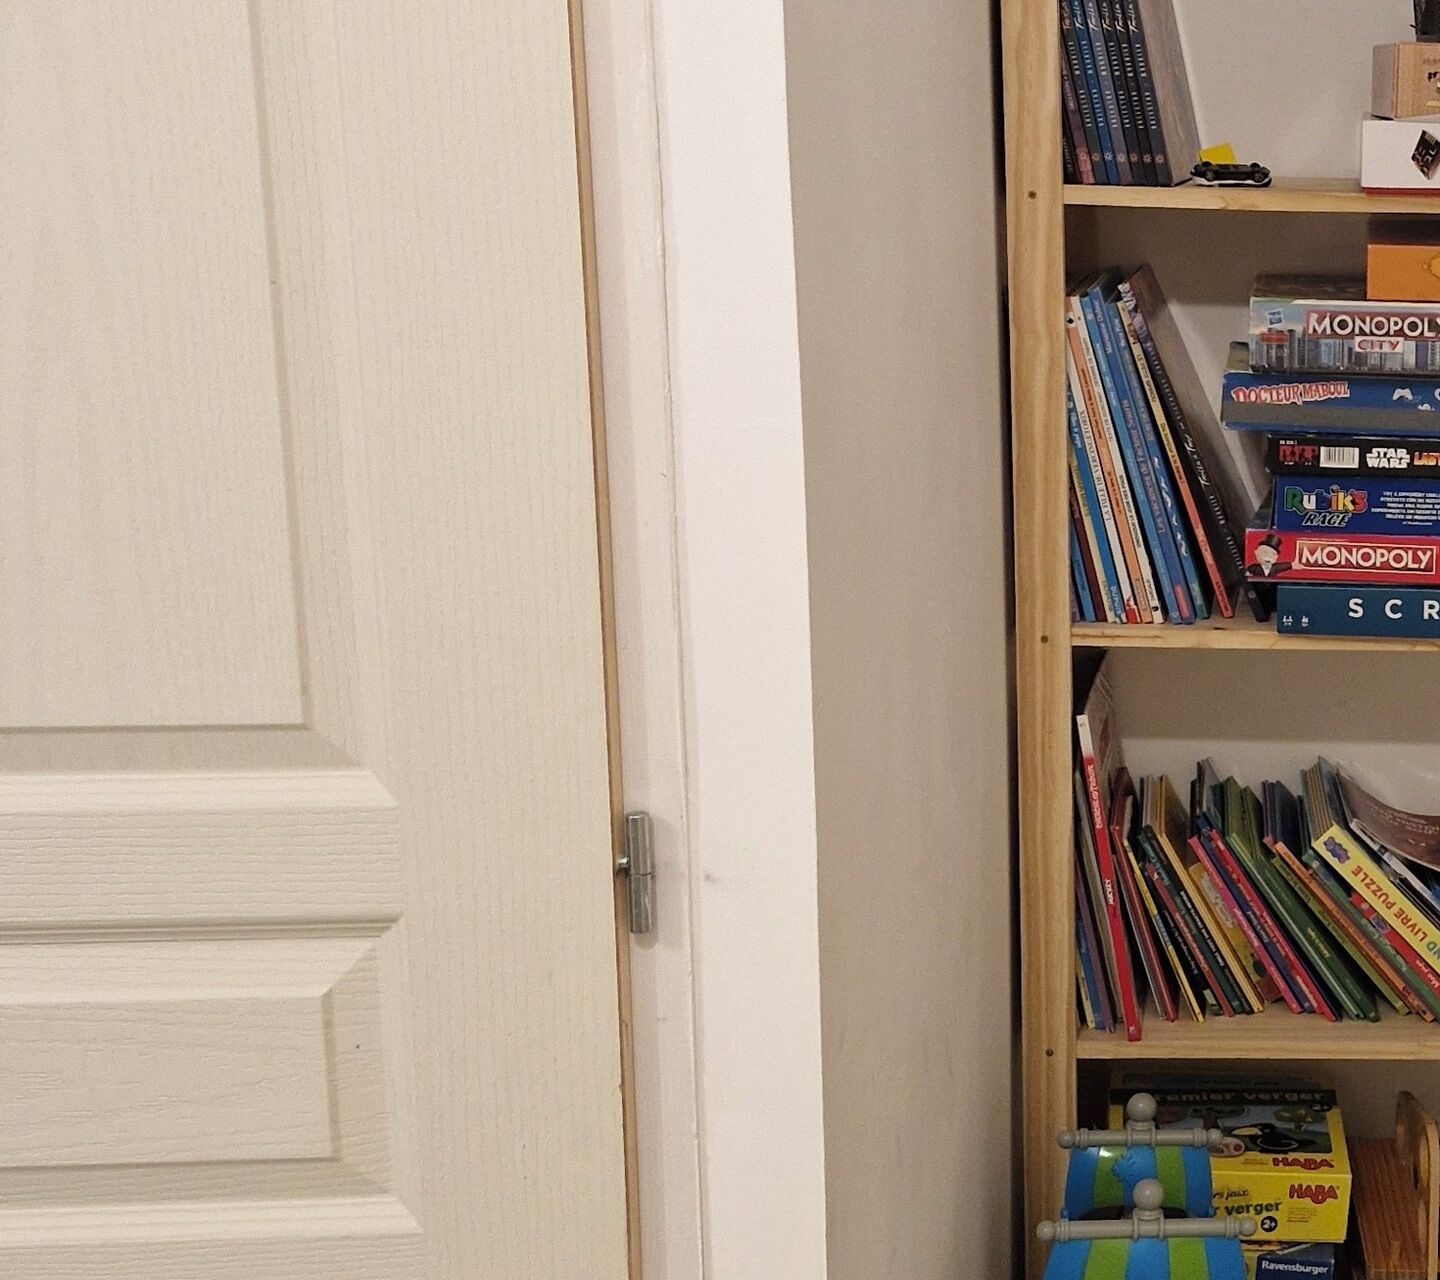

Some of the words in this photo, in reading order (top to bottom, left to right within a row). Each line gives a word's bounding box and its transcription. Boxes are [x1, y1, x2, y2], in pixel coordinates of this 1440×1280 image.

[1357, 339, 1400, 351] CITY
[1232, 385, 1300, 404] DOCTEUR
[1302, 381, 1349, 399] MABOUL
[1366, 448, 1411, 459] STAR
[1366, 458, 1410, 468] WARS
[1302, 512, 1352, 527] RACE
[1301, 546, 1432, 569] MONOPOLY
[1350, 861, 1397, 913] PUZZLE
[1392, 904, 1429, 945] LIVRE
[1272, 1157, 1334, 1170] HABA
[1289, 1183, 1339, 1205] HABA
[1224, 1201, 1282, 1217] verger
[1263, 1220, 1276, 1230] 2+
[1261, 1260, 1329, 1275] Ravensburger
